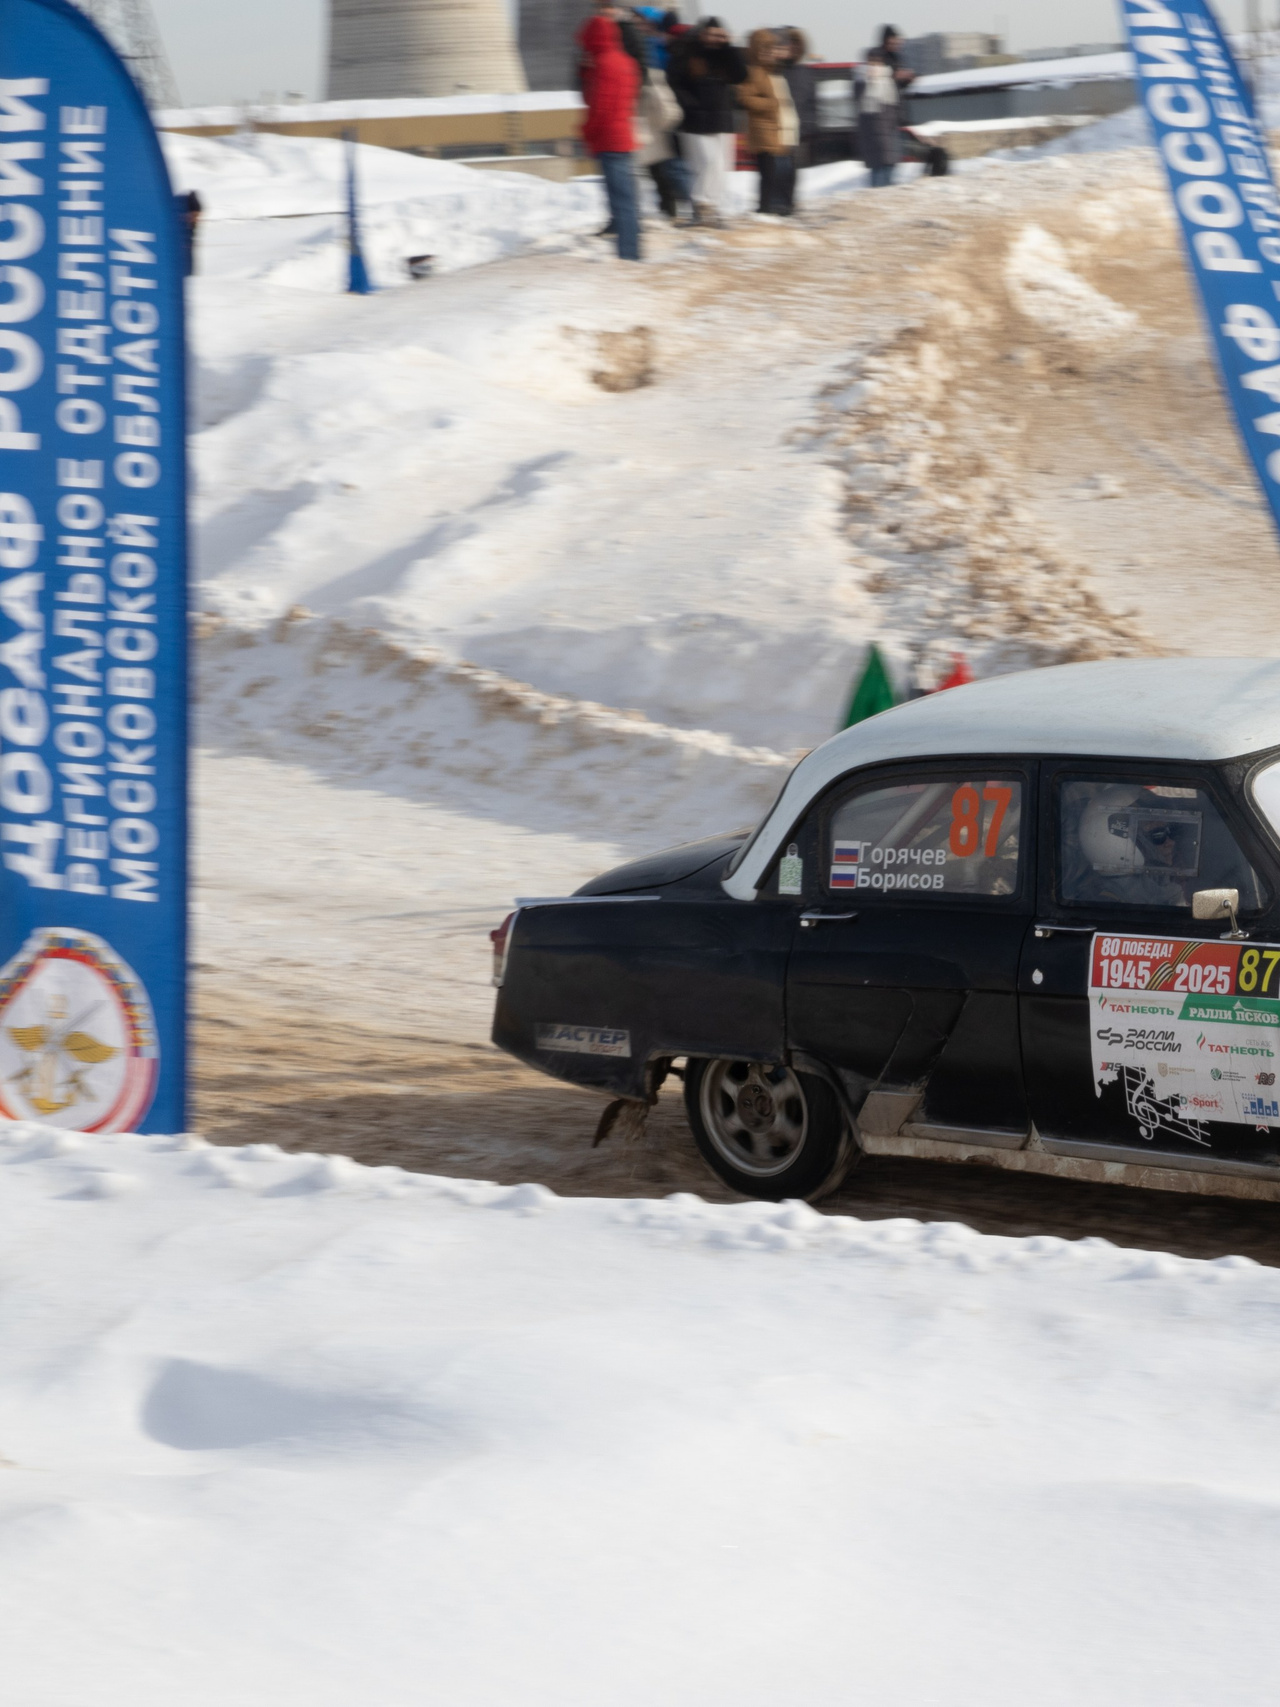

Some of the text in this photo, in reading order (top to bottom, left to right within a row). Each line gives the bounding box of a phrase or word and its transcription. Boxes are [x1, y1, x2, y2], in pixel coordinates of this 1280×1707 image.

[1121, 0, 1263, 273] РОССИИ
[0, 78, 66, 890] ДОСААФ РОССИИ
[52, 106, 112, 895] РЕГИОНАЛЬНОЕ ОТДЕЛЕНИЕ
[105, 229, 161, 902] МОСКОВСКОЙ ОБЛАСТИ
[950, 787, 1013, 857] 87
[860, 842, 946, 869] Горячев
[857, 868, 944, 892] Борисов
[1101, 938, 1173, 958] 80 ПОБЕДА!
[1100, 959, 1230, 995] 1945 2025
[1110, 1003, 1175, 1016] ТАТНЕФТЬ
[1189, 1007, 1280, 1024] РАЛЛИ ПСКОВ
[1123, 1040, 1182, 1053] РОССИИ
[1126, 1028, 1175, 1041] РАЛЛИ
[1208, 1044, 1275, 1058] ТАТНЕФТЬ
